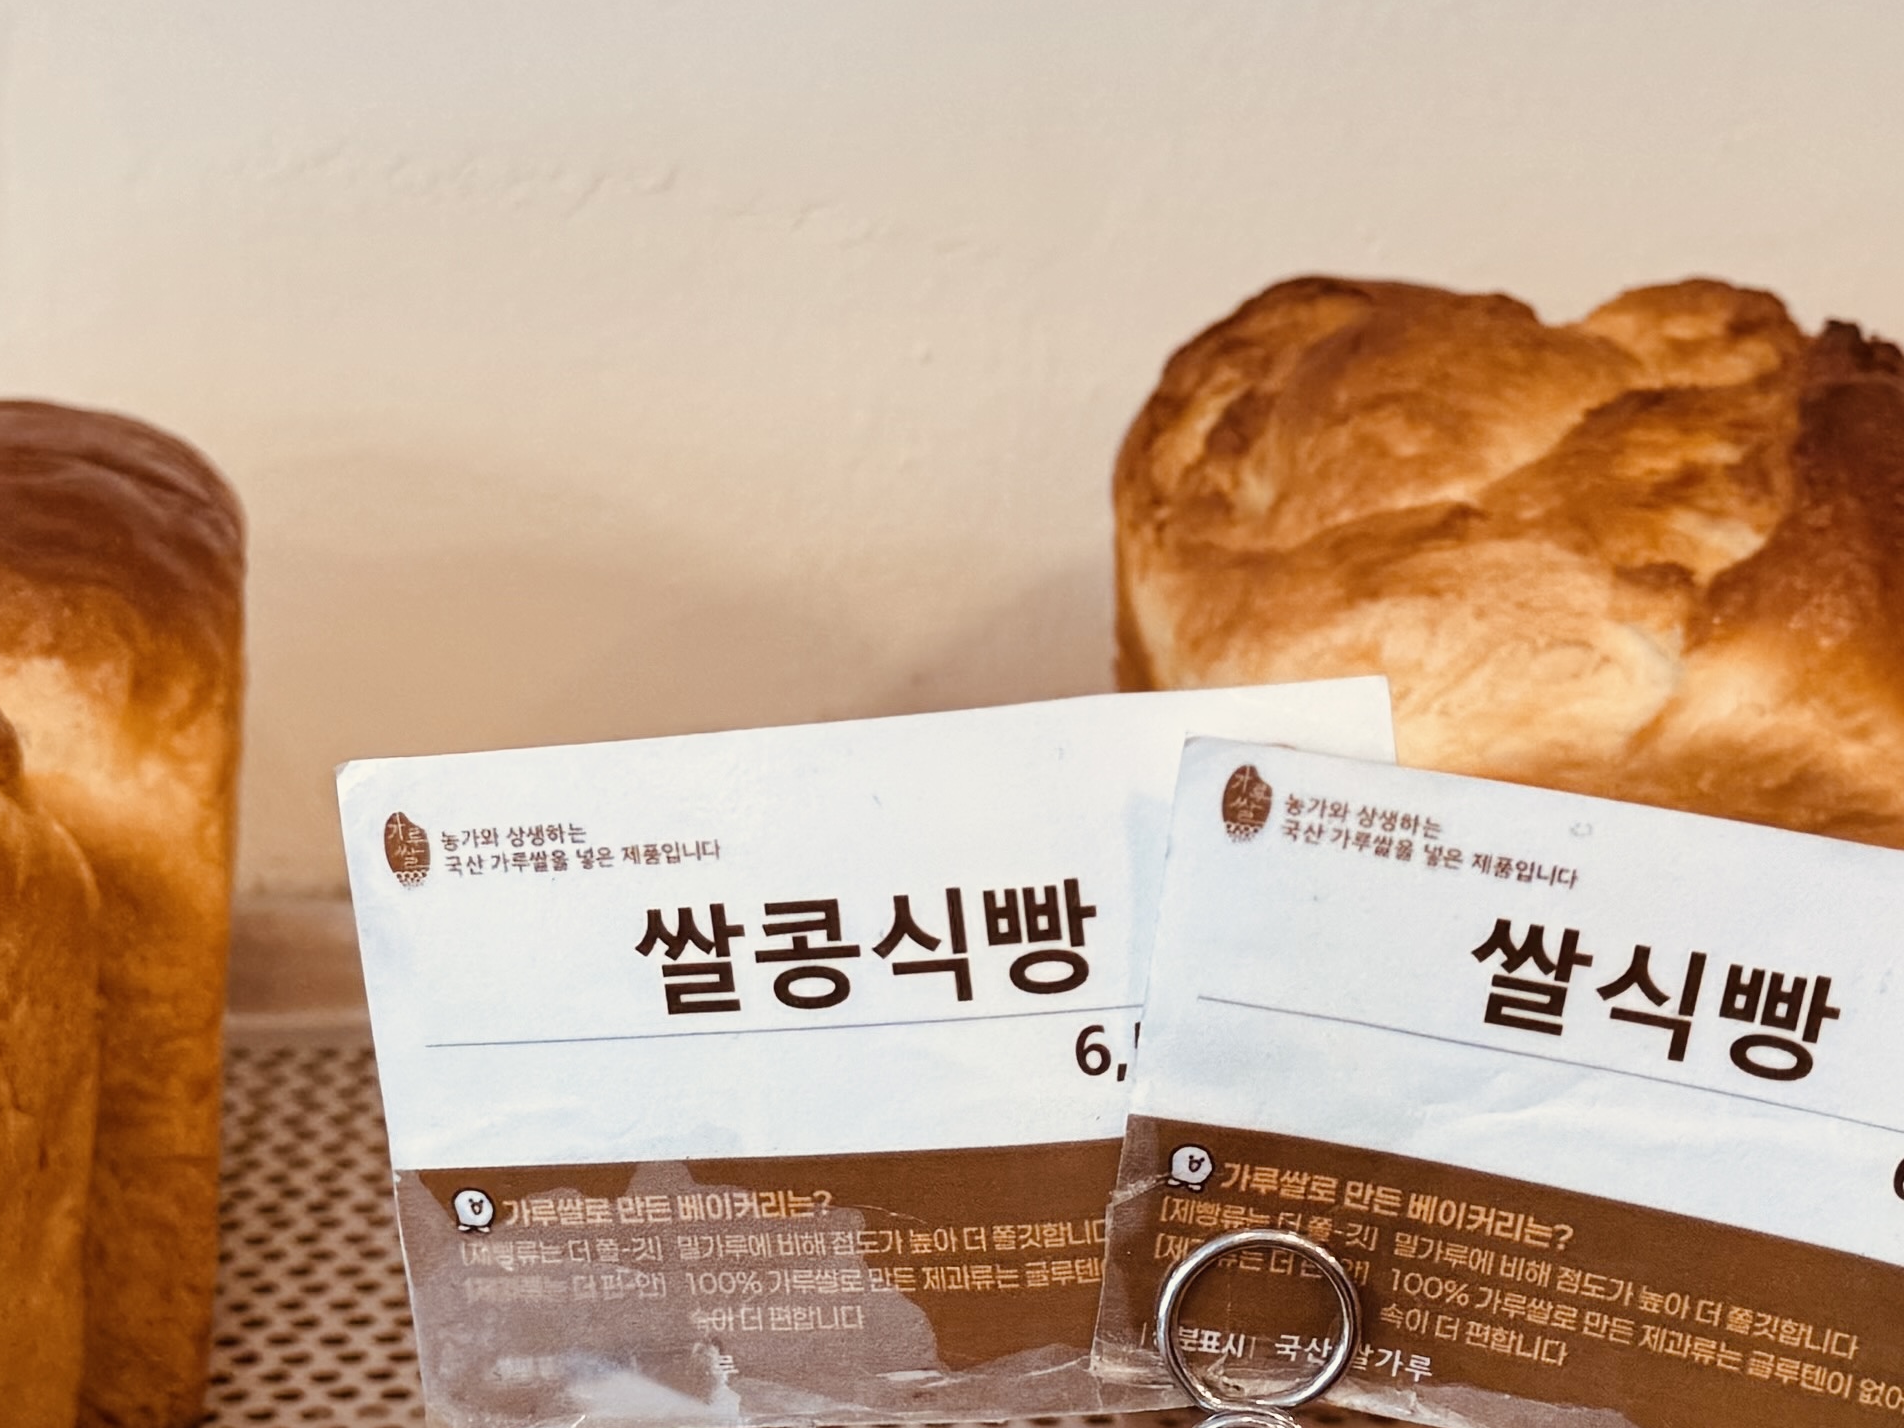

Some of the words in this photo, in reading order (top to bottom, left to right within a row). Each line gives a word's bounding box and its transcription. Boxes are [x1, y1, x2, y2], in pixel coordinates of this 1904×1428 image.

[441, 828, 499, 853] 농가와
[506, 822, 588, 849] 상생하는
[1284, 792, 1349, 823] 농가와
[1355, 803, 1444, 841] 상생하는
[444, 853, 484, 877] 국산
[491, 849, 570, 875] 가루쌀을
[575, 846, 615, 870] 넣은
[622, 839, 722, 867] 제품입니다
[1280, 819, 1326, 845] 국산
[1330, 825, 1416, 863] 가루쌀을
[1423, 842, 1464, 871] 넣은
[1470, 852, 1580, 890] 제품입니다
[634, 878, 1097, 1015] 쌀콩식빵
[1471, 918, 1841, 1082] 쌀식빵
[1074, 1021, 1141, 1083] 6,
[502, 1197, 614, 1227] 가루쌀로
[617, 1194, 673, 1223] 만든
[677, 1190, 833, 1222] 베이커리는?
[1222, 1161, 1337, 1205] 가루쌀로
[1342, 1179, 1403, 1217] 만든
[1406, 1192, 1576, 1250] 베이커리는?
[568, 1238, 592, 1263] 더
[677, 1231, 772, 1261] 밀가루에
[777, 1230, 827, 1259] 비해
[831, 1228, 903, 1257] 점도가
[910, 1226, 959, 1256] 높아
[963, 1224, 987, 1253] 더
[684, 1270, 763, 1298] 100%
[769, 1268, 862, 1297] 가루쌀로
[868, 1266, 917, 1294] 만든
[923, 1264, 1020, 1293] 제과류는
[1024, 1257, 1106, 1289] 글루텐
[1158, 1195, 1272, 1230] [제빵류는
[1393, 1231, 1496, 1276] 밀가루에
[1499, 1254, 1552, 1288] 비해
[1555, 1265, 1634, 1308] 점도가
[1638, 1285, 1691, 1321] 높아
[1695, 1299, 1723, 1328] 더
[1726, 1304, 1859, 1360] 쫄깃합니다
[740, 1305, 763, 1332] 더
[769, 1304, 865, 1332] 편합니다
[1379, 1303, 1430, 1336] 속이
[1434, 1314, 1461, 1341] 더
[1464, 1319, 1569, 1367] 편합니다
[1390, 1268, 1470, 1308] 100%
[1475, 1285, 1578, 1333] 가루쌀로
[1582, 1309, 1636, 1347] 만든
[1639, 1323, 1745, 1373] 제과류는
[1746, 1348, 1853, 1400] 글루텐이
[1274, 1333, 1334, 1367] 국산
